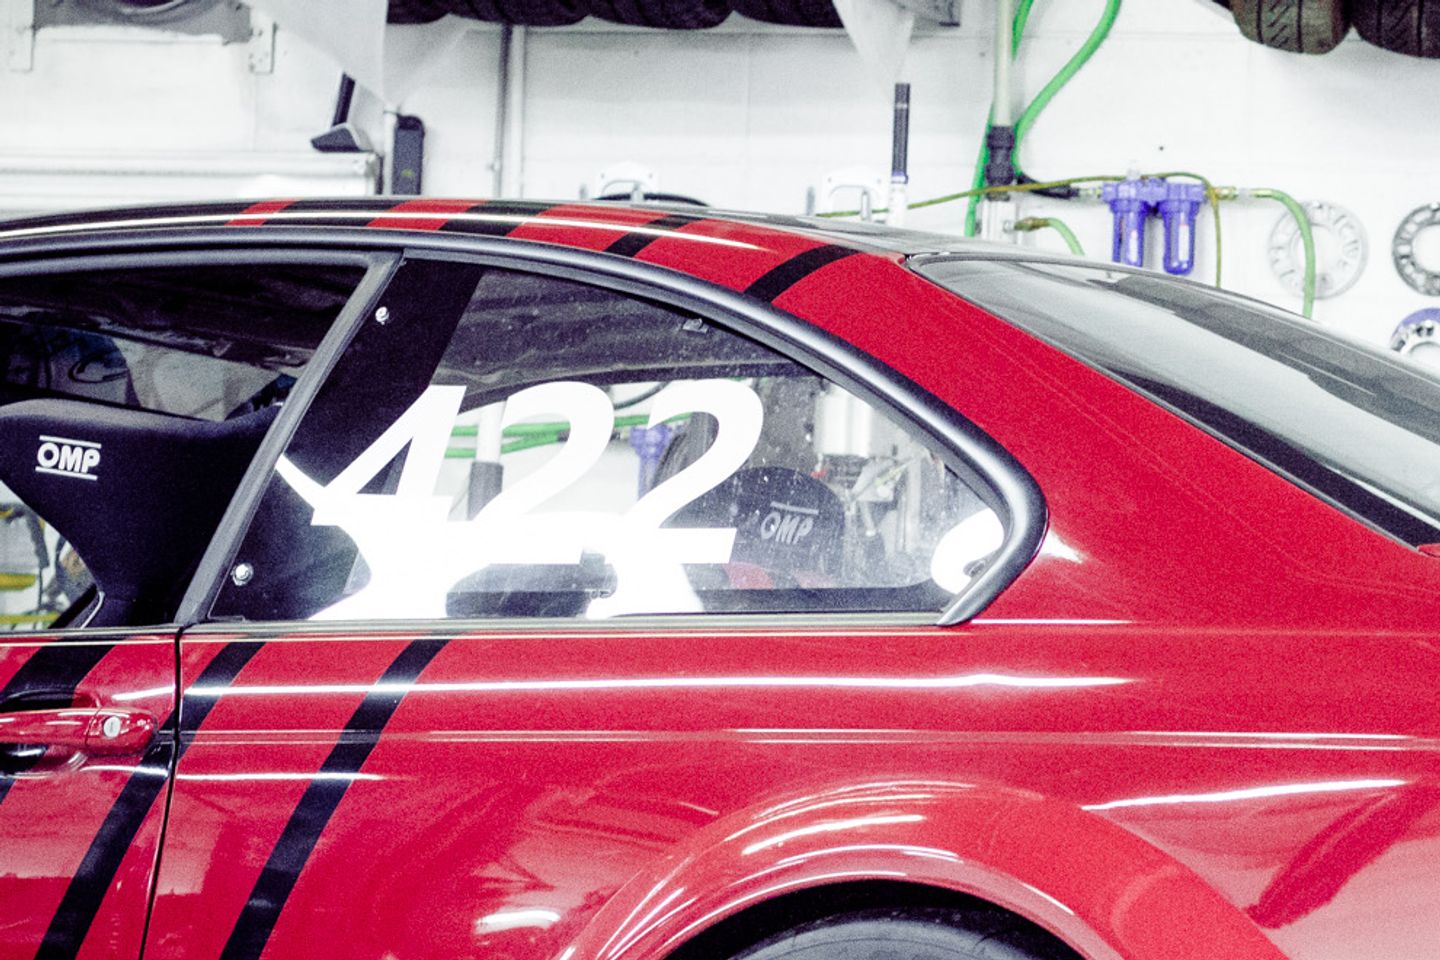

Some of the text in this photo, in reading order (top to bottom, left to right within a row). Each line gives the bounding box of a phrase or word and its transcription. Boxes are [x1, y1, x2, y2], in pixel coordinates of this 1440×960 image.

[37, 442, 101, 474] OMP
[311, 380, 765, 564] 422
[760, 511, 814, 545] OMP
